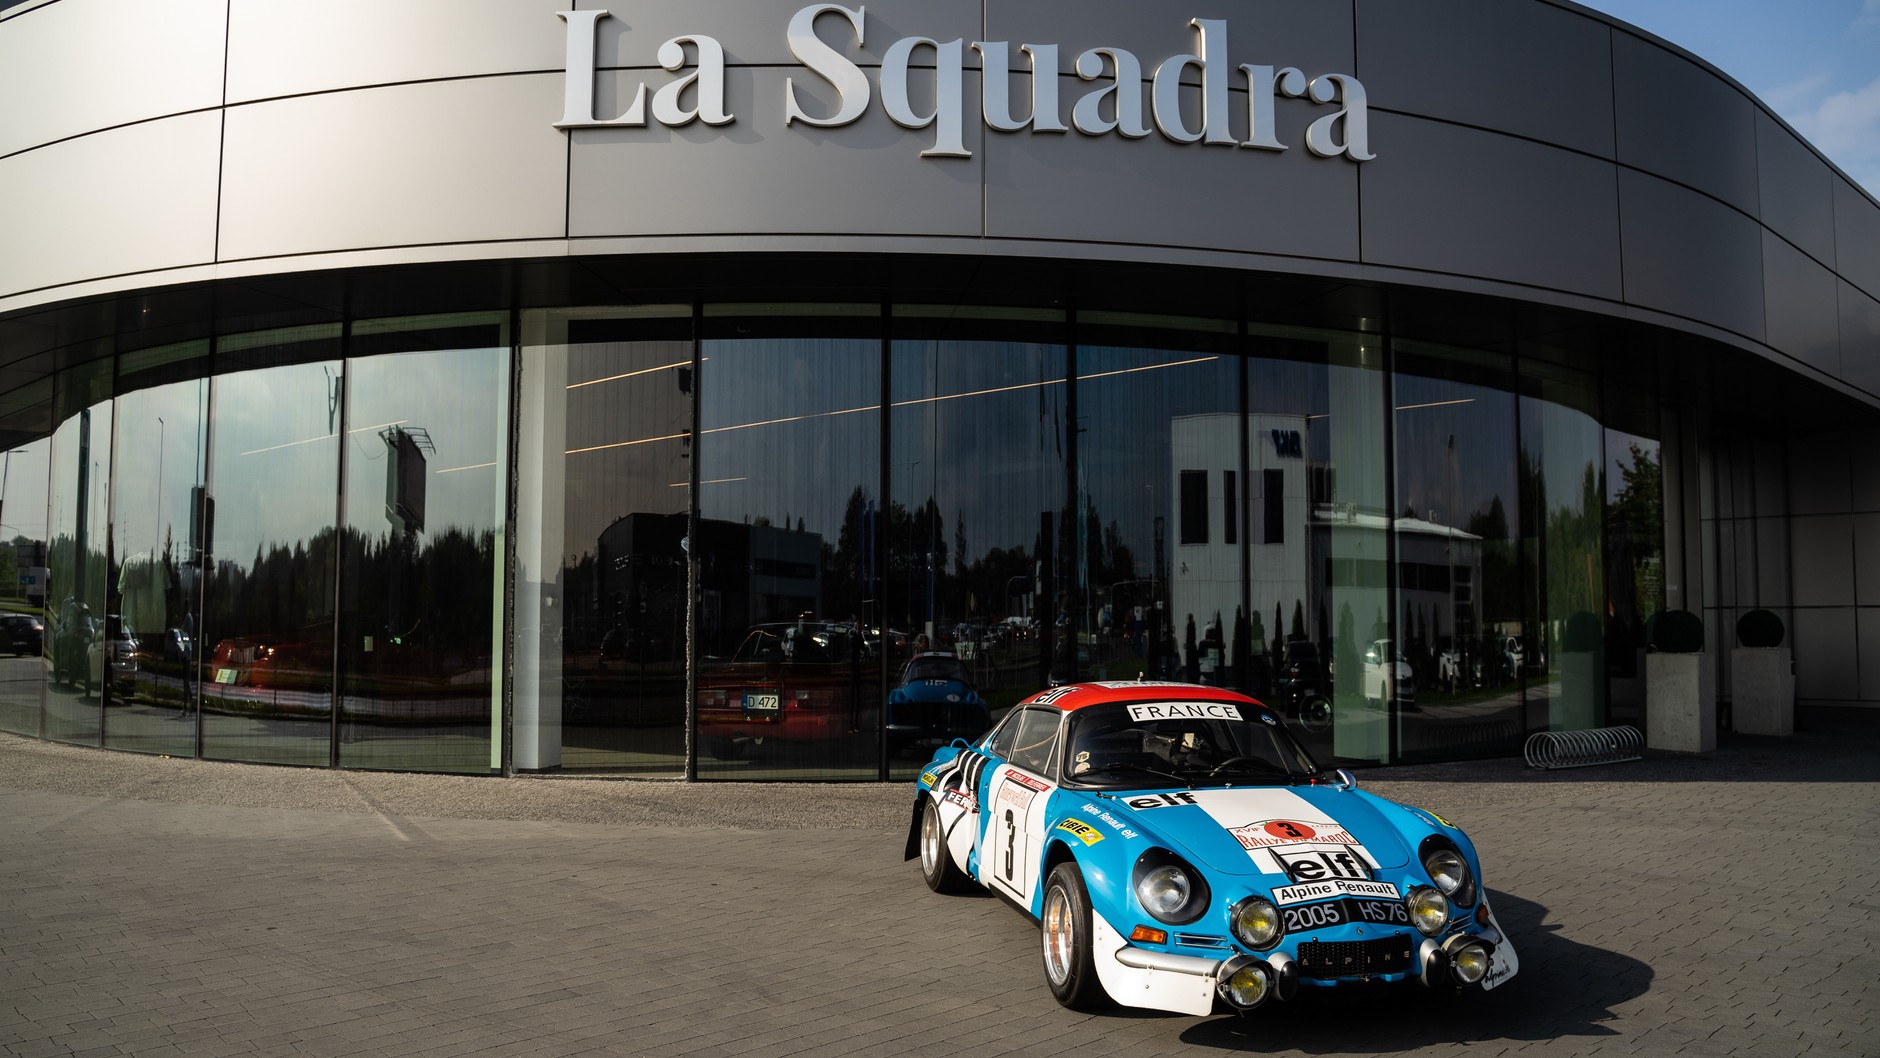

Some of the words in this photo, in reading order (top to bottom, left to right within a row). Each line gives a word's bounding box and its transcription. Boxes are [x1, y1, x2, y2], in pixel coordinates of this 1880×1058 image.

[553, 9, 736, 128] La
[786, 3, 1377, 162] Squadra
[758, 696, 777, 708] 472
[1131, 704, 1239, 720] FRANCE
[1128, 791, 1198, 809] elf
[1059, 819, 1090, 835] CIBIE
[1080, 802, 1102, 816] Alpine
[1098, 811, 1127, 831] Renault
[1120, 829, 1139, 840] elf
[1276, 822, 1303, 837] 3
[1004, 808, 1016, 882] 3
[1235, 834, 1288, 848] RALLYE
[1310, 830, 1357, 844] MAROC
[1290, 852, 1361, 879] elf
[1280, 883, 1332, 901] Alpine
[1335, 880, 1395, 896] Renault
[1284, 903, 1340, 931] 2005
[1357, 901, 1409, 923] HS76
[1302, 950, 1410, 966] ALPINE
